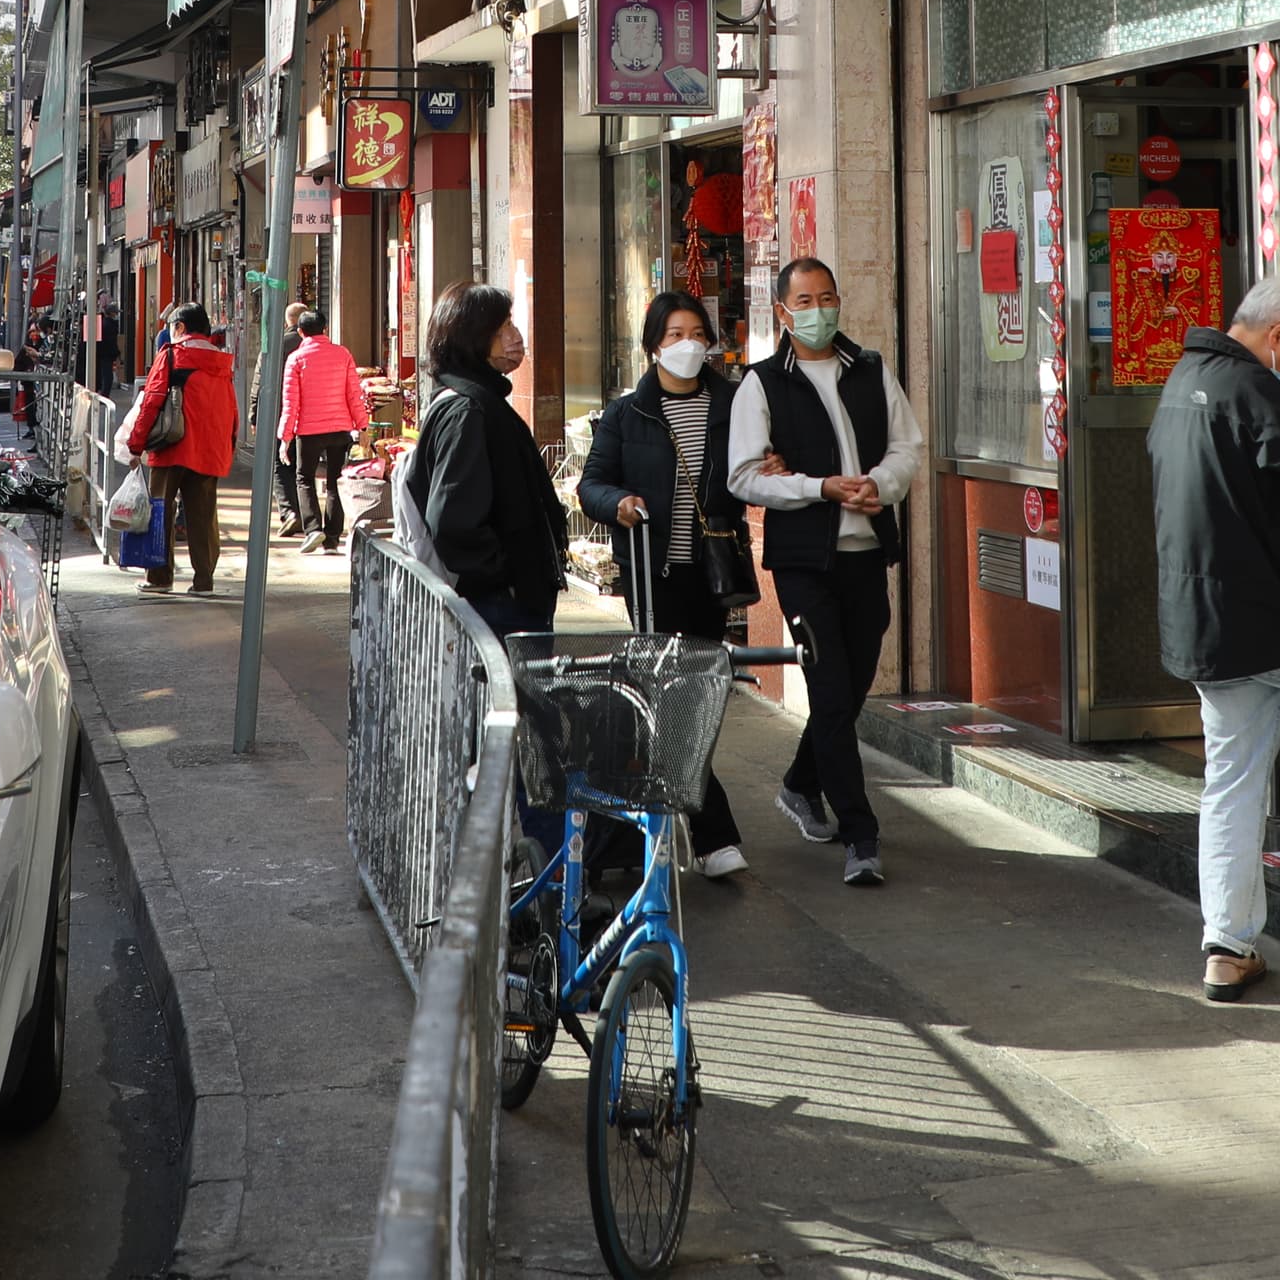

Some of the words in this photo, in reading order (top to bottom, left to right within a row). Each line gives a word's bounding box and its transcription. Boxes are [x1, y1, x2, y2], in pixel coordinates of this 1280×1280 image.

[428, 92, 456, 107] ADT
[351, 102, 382, 168] 祥德
[1139, 154, 1181, 163] MICHELIN
